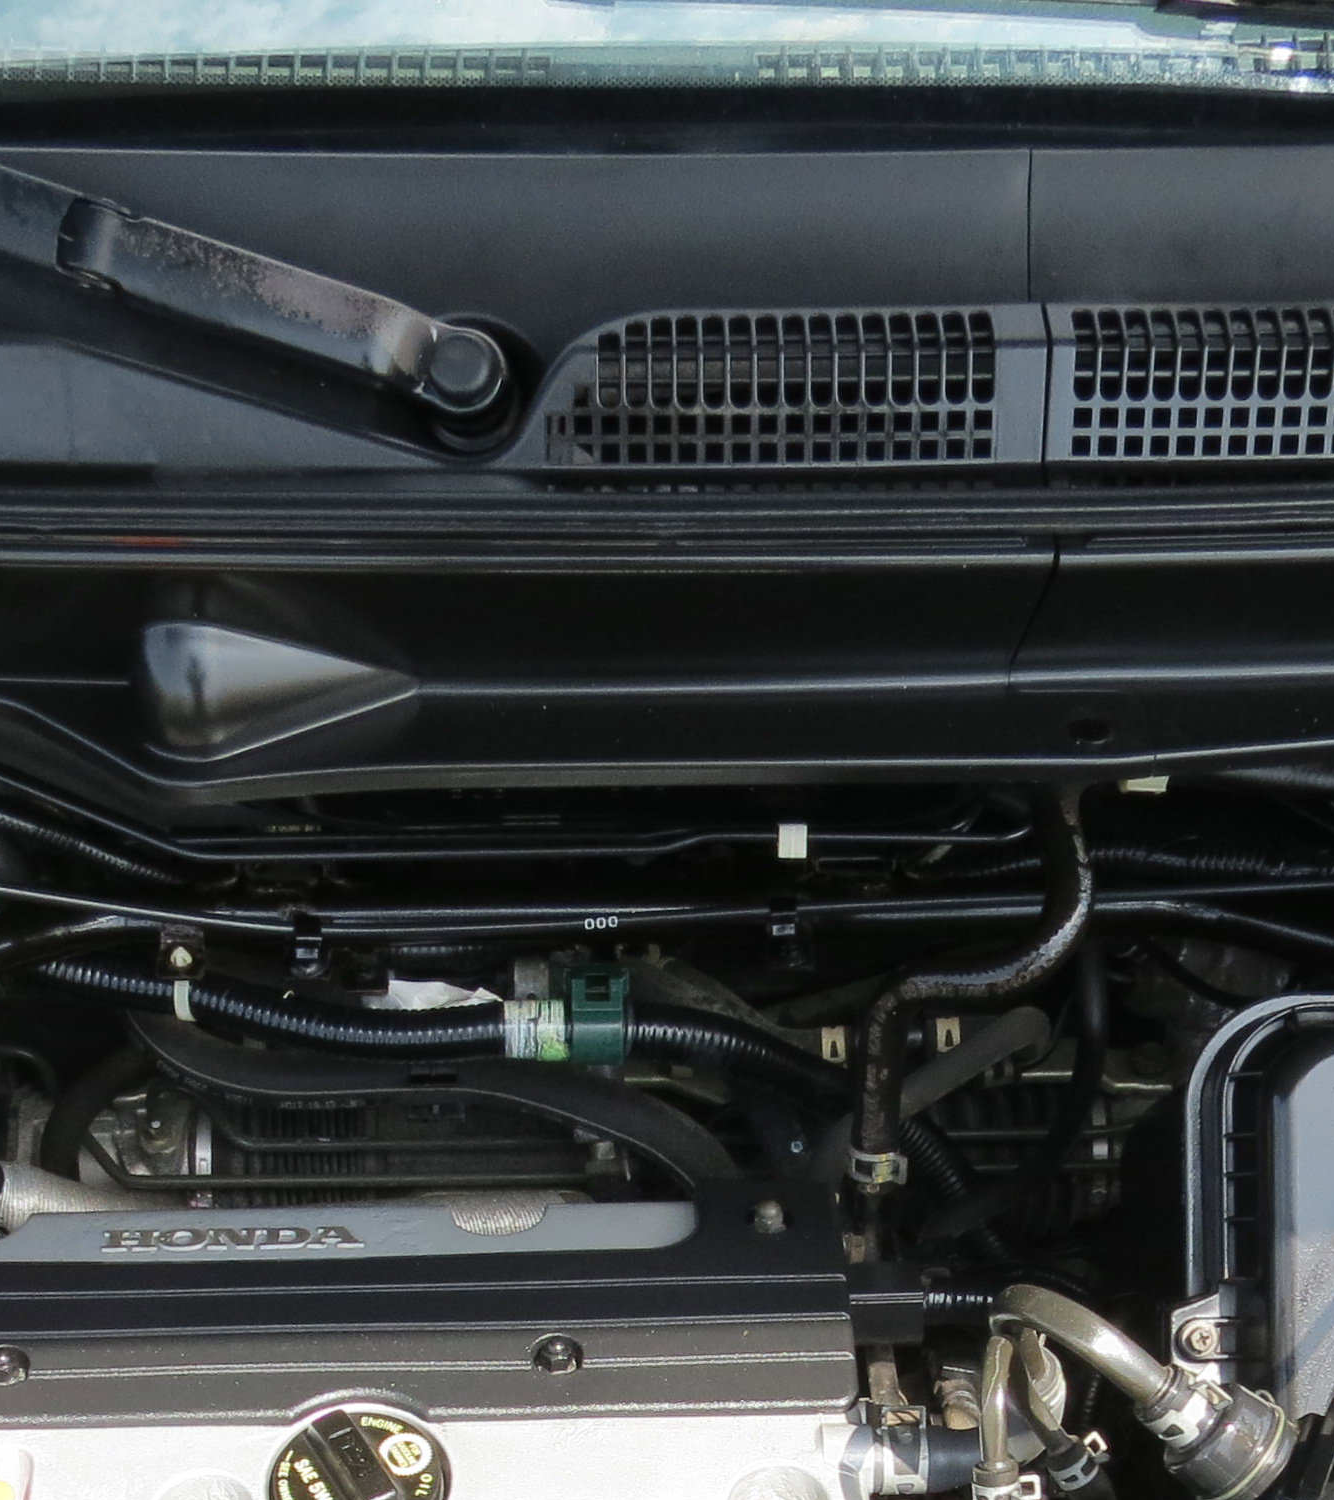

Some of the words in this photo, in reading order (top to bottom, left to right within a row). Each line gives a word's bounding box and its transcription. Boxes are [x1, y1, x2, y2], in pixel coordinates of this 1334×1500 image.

[101, 1226, 365, 1252] HONDA
[361, 1416, 404, 1434] ENGINE
[278, 1461, 291, 1478] SEE
[294, 1459, 318, 1484] SAE
[415, 1473, 433, 1497] OIL
